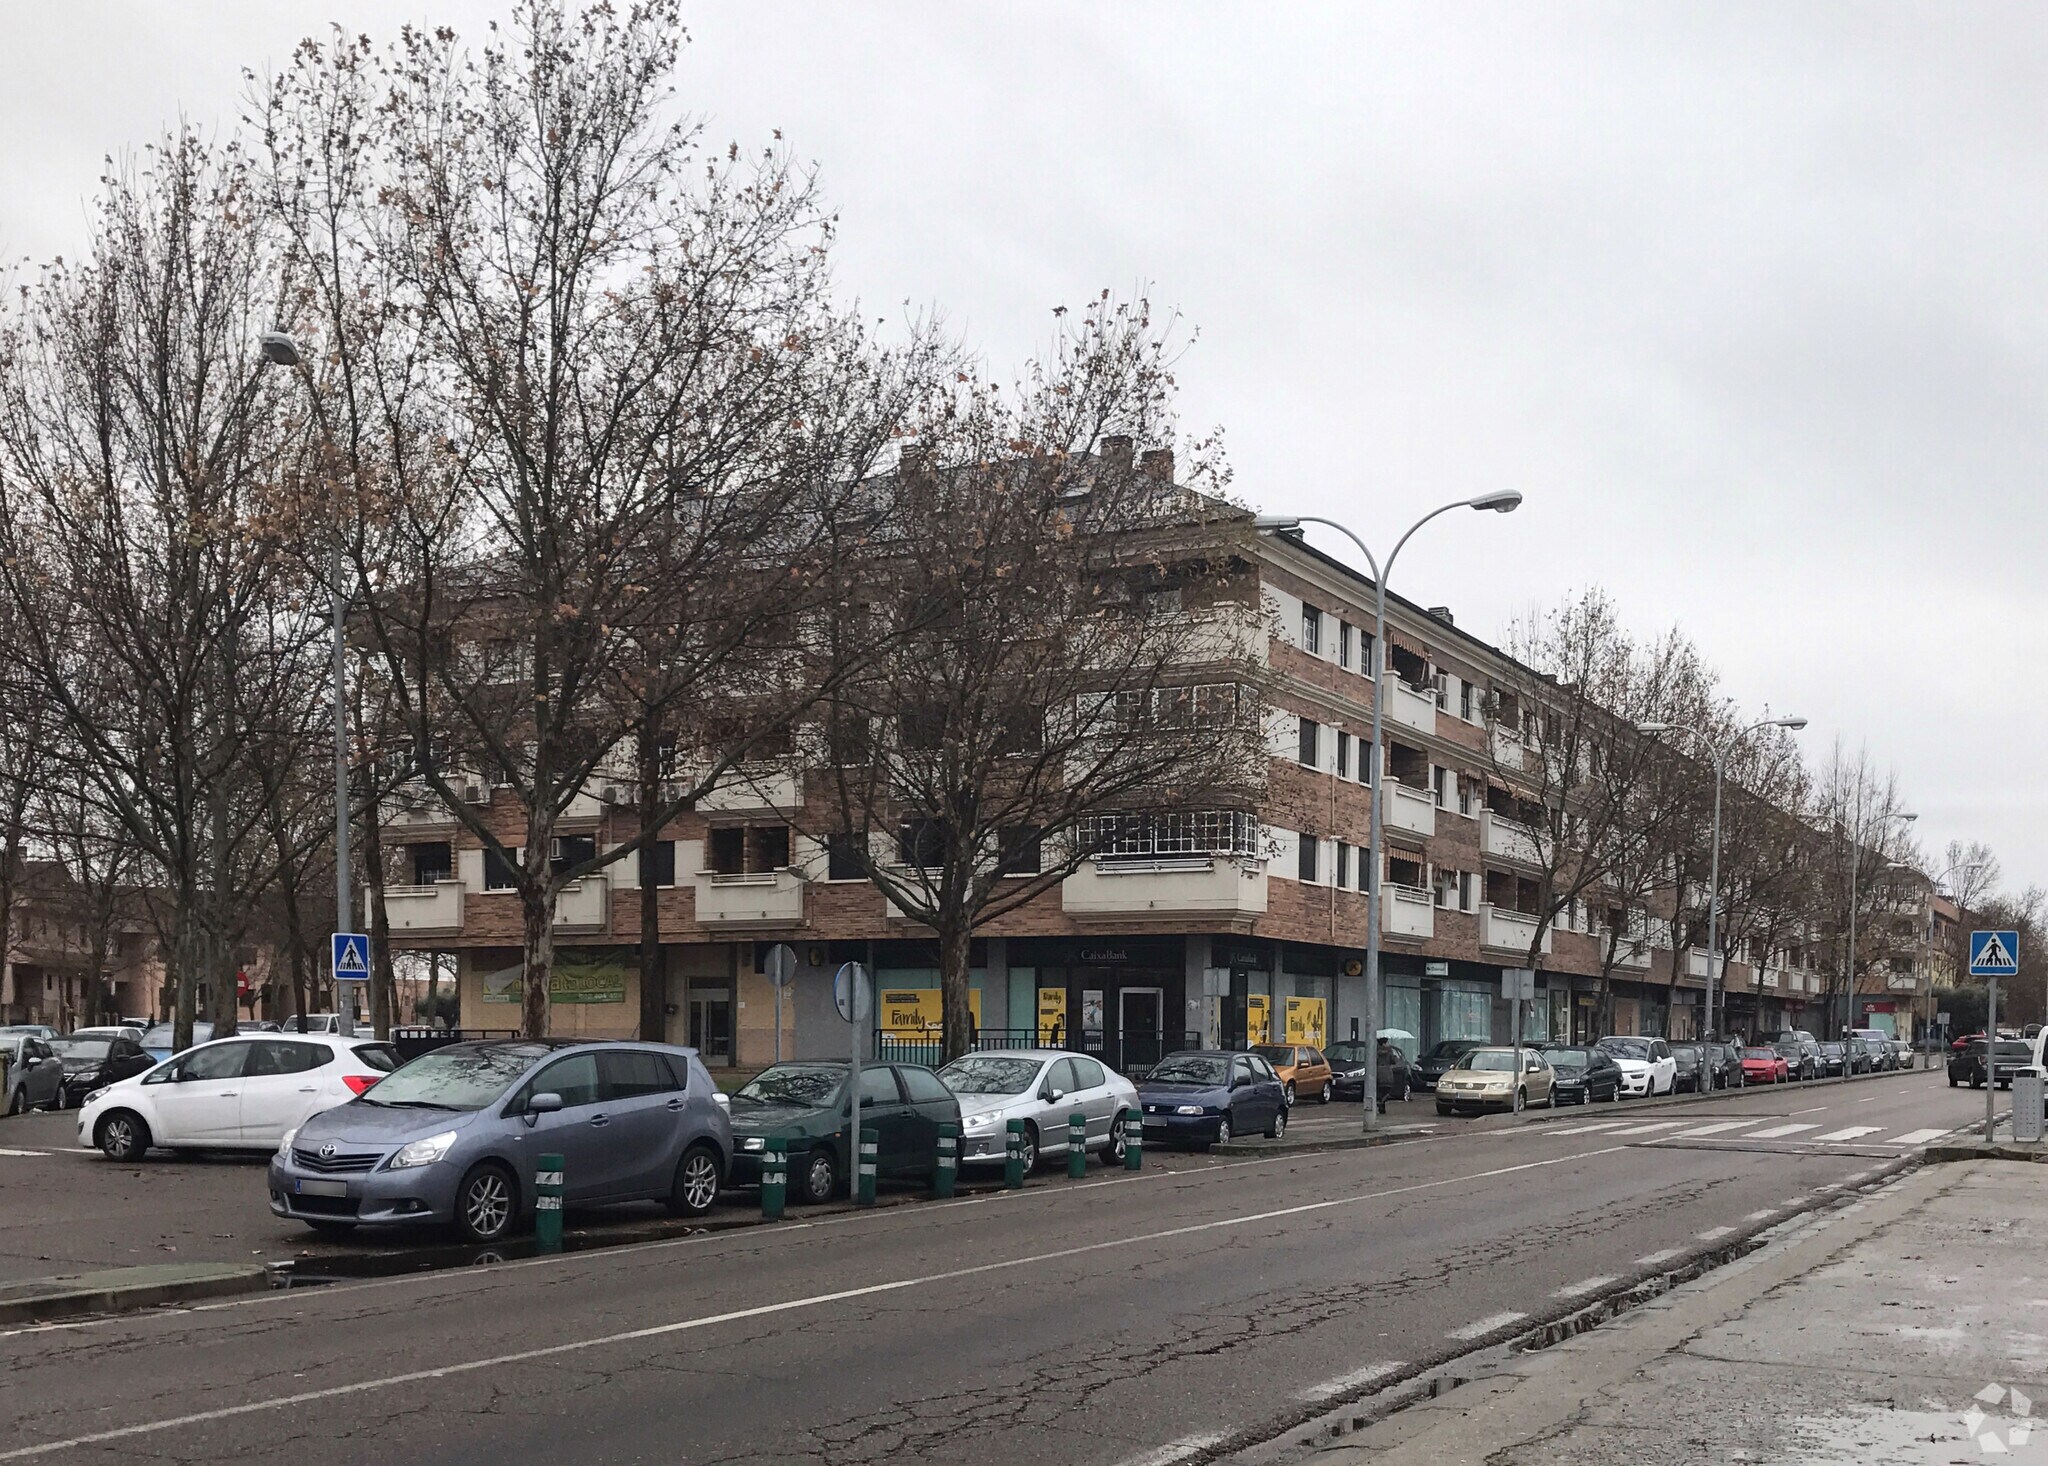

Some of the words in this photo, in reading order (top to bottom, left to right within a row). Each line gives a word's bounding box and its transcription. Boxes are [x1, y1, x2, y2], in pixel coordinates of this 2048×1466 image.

[1081, 949, 1128, 960] CaixaBank
[579, 974, 623, 990] LOCAL
[891, 1008, 925, 1033] Family
